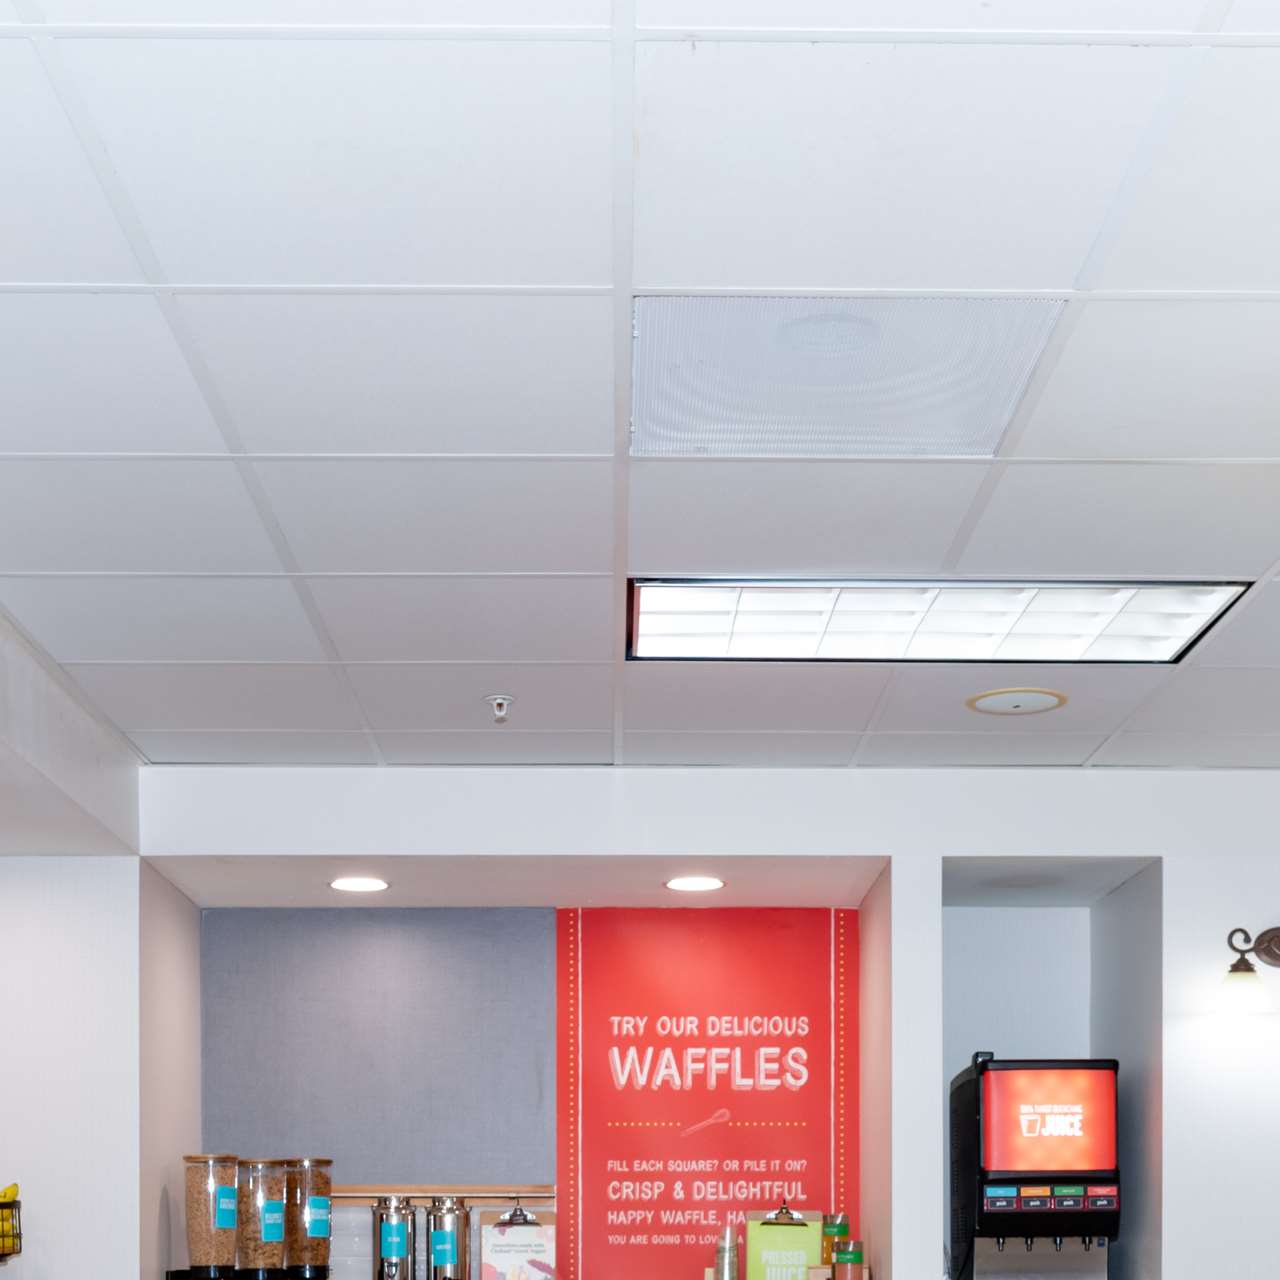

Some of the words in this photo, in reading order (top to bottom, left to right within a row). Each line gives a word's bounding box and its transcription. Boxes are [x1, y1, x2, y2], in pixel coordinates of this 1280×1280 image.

[609, 1015, 648, 1037] TRY
[656, 1015, 699, 1037] OUR
[706, 1015, 810, 1037] DELICIOUS
[608, 1045, 810, 1092] WAFFLES
[1040, 1113, 1083, 1137] JUICE
[607, 1160, 629, 1172] FILL
[633, 1160, 664, 1172] EACH
[667, 1159, 720, 1172] SQUARE?
[723, 1160, 740, 1172] OR
[743, 1160, 767, 1172] PILE
[770, 1160, 780, 1171] IT
[784, 1159, 808, 1171] ON?
[608, 1180, 665, 1201] CRISP
[673, 1180, 685, 1201] &
[692, 1180, 808, 1201] DELIGHTFUL
[607, 1210, 654, 1225] HAPPY
[660, 1210, 722, 1227] WAFFLE,
[607, 1234, 626, 1245] YOU
[629, 1234, 649, 1245] ARE
[651, 1234, 681, 1245] GOING
[684, 1234, 697, 1245] TO
[698, 1234, 719, 1245] LOV
